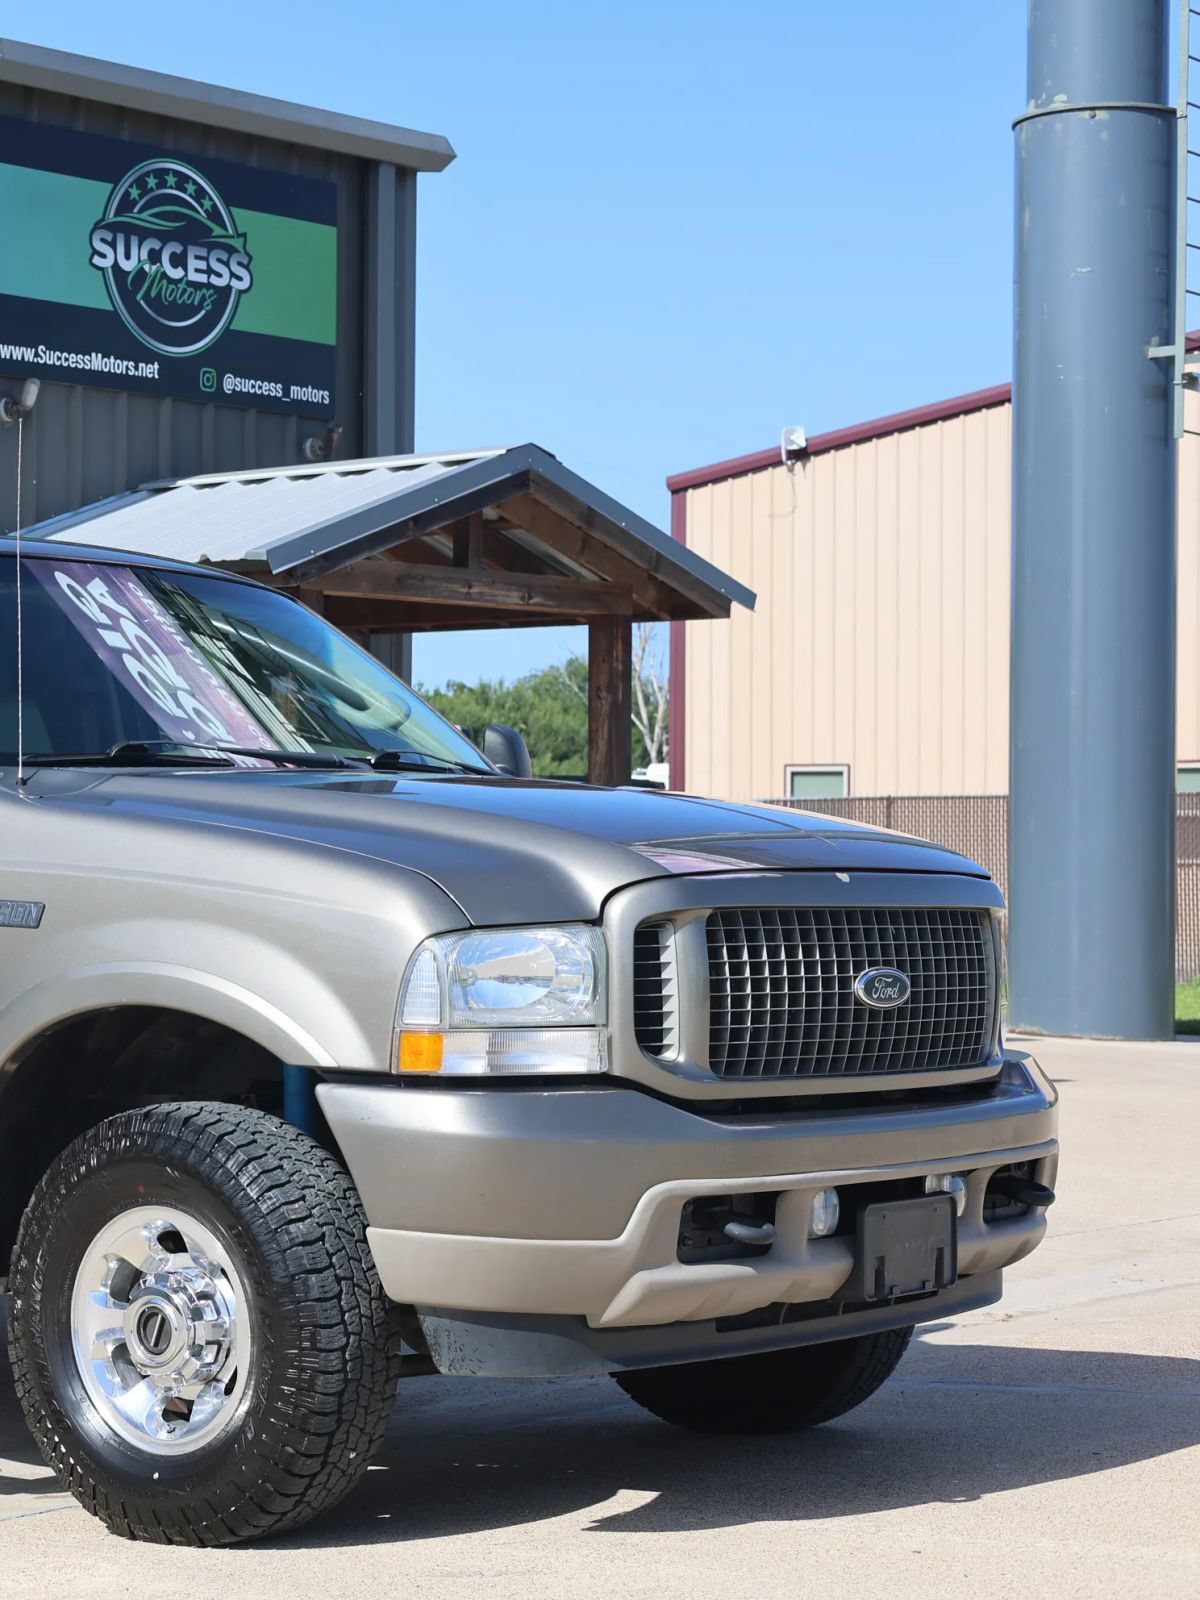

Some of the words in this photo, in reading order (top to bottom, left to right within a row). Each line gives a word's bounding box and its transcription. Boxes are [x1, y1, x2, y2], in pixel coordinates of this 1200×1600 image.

[92, 229, 251, 290] SUCCESS
[127, 259, 217, 310] Motors
[0, 344, 159, 379] www.SuccessMotors.net
[223, 373, 330, 404] @success_motors
[872, 976, 900, 999] Ford
